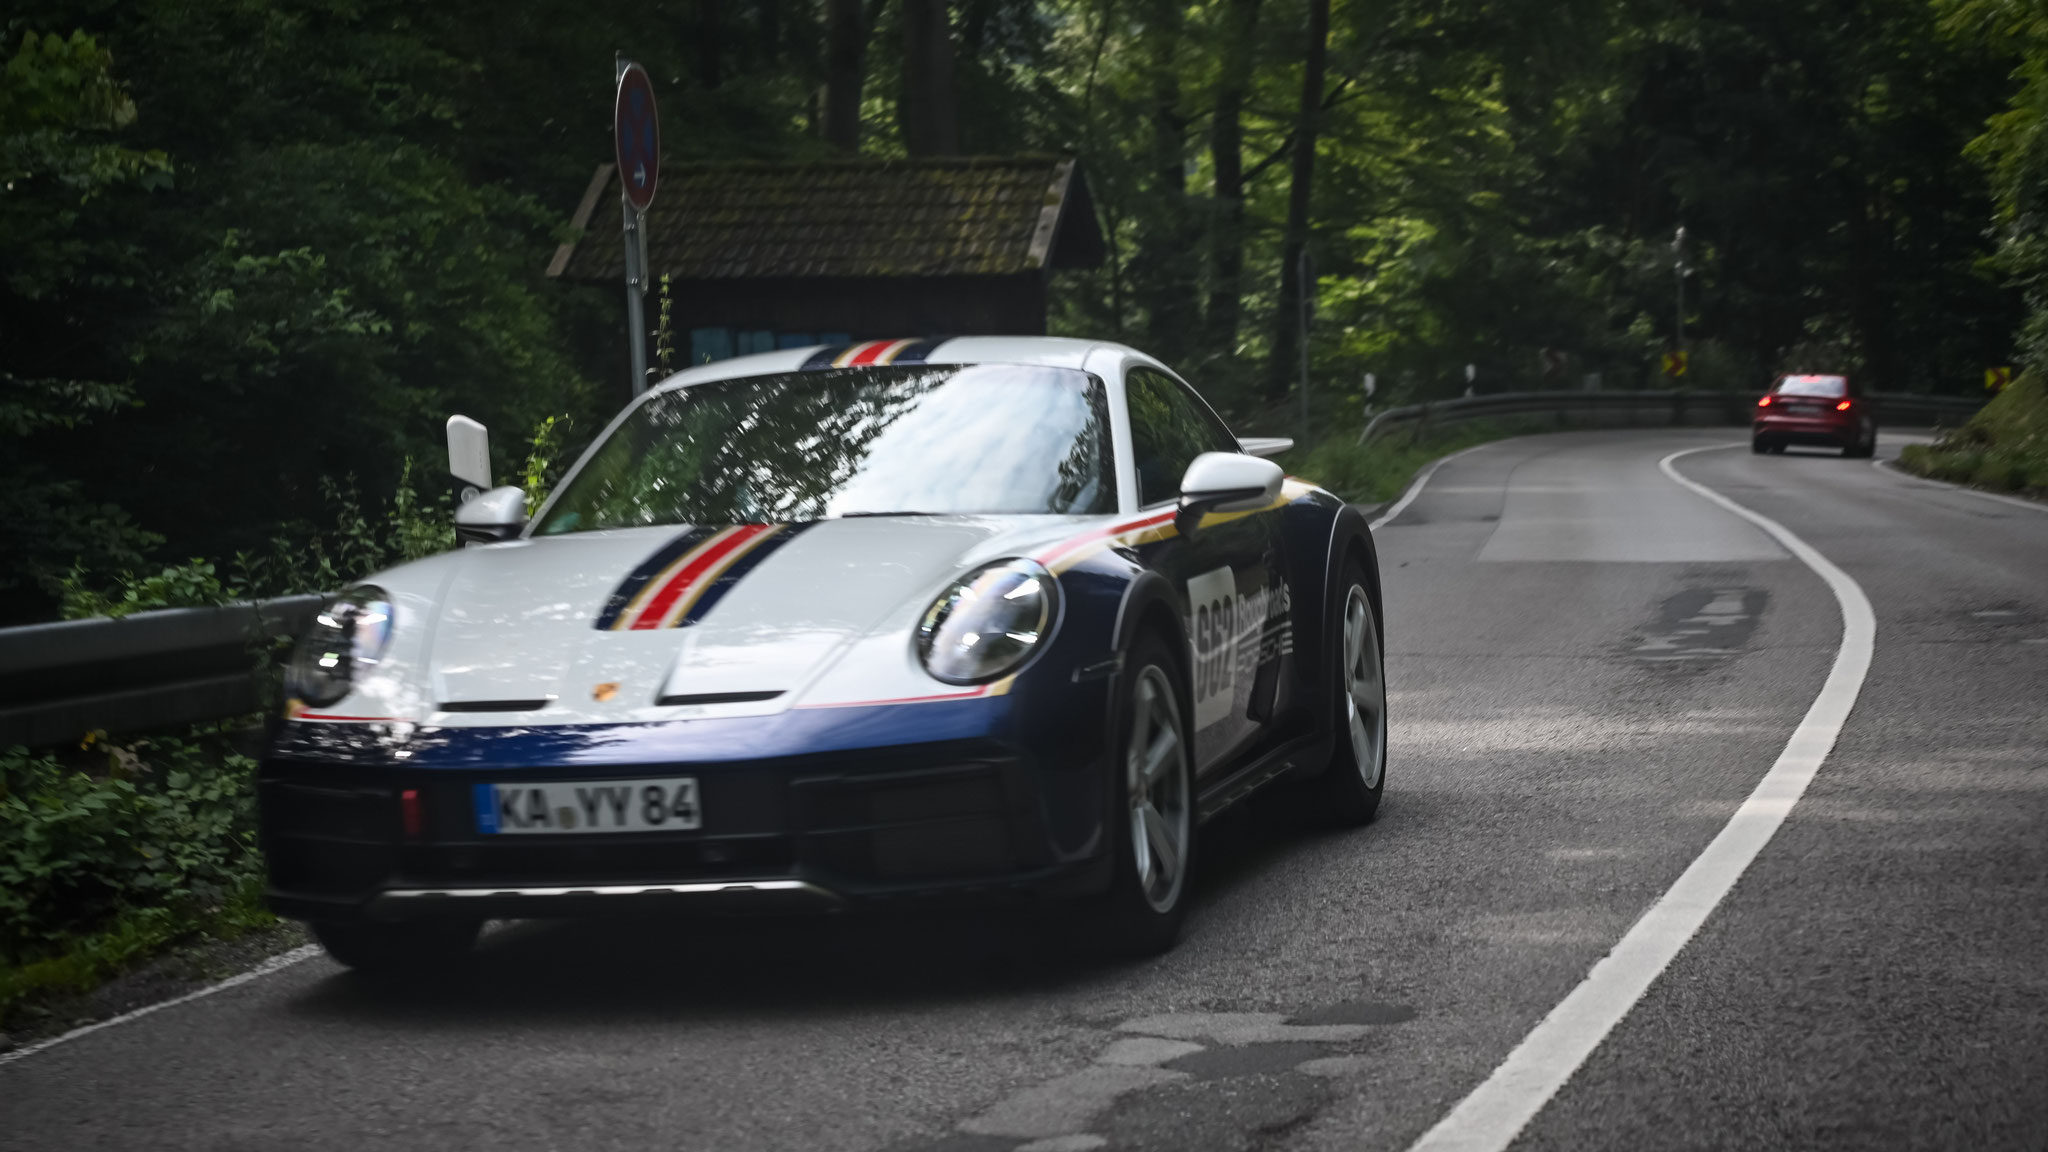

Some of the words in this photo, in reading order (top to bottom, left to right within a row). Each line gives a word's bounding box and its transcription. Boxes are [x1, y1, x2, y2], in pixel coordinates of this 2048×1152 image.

[498, 788, 552, 829] KA
[574, 786, 632, 827] YY
[639, 783, 698, 826] 84
